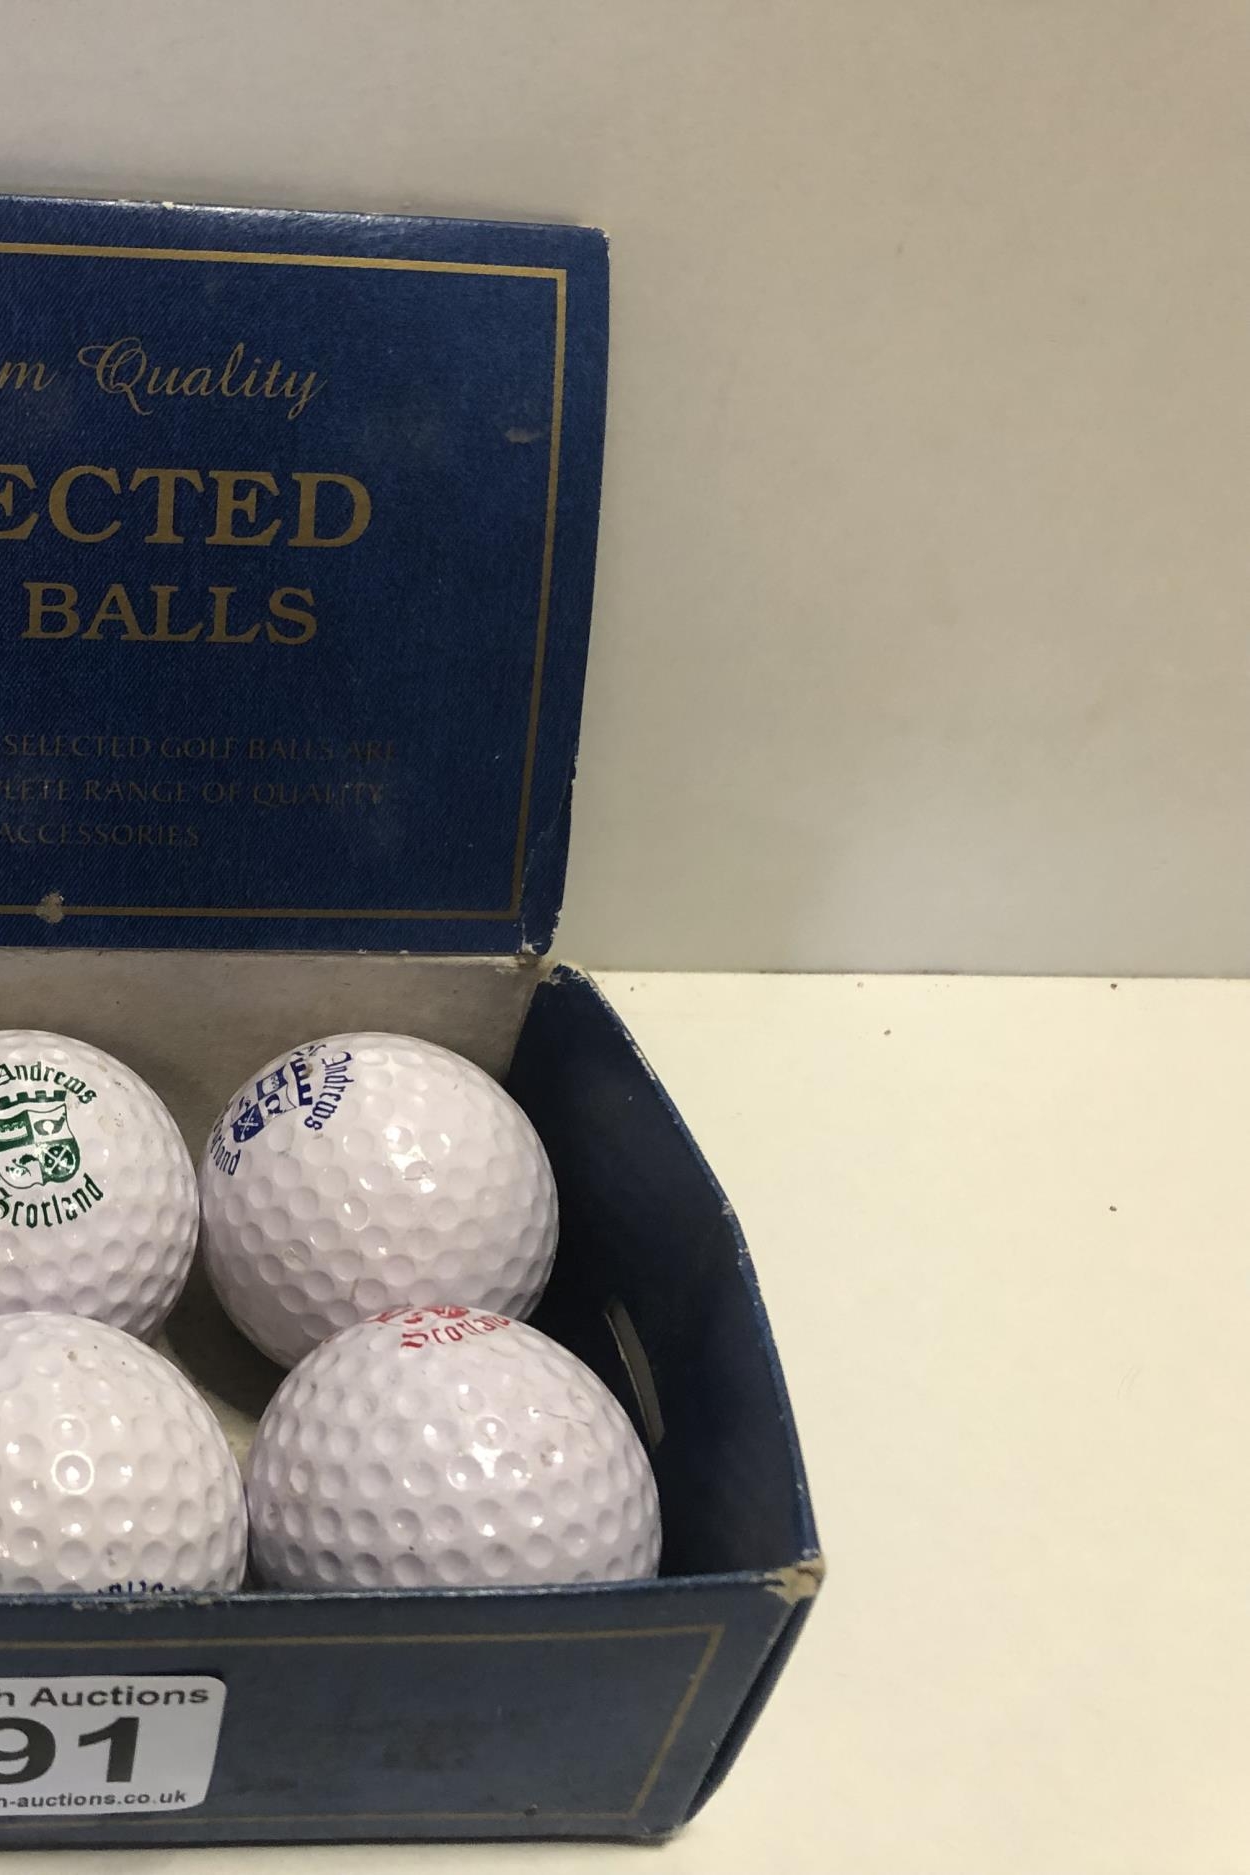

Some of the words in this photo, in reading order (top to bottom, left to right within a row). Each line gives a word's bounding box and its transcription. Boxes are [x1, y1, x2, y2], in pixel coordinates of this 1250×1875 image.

[77, 336, 328, 419] Quality
[21, 581, 318, 645] BALLS
[4, 733, 151, 758] SELECTED
[161, 736, 238, 760] GOLF
[249, 737, 335, 762] BALLS
[84, 780, 190, 803] RANGE
[203, 782, 247, 804] OF
[303, 1050, 355, 1131] Andrews
[30, 1685, 210, 1708] Auctions
